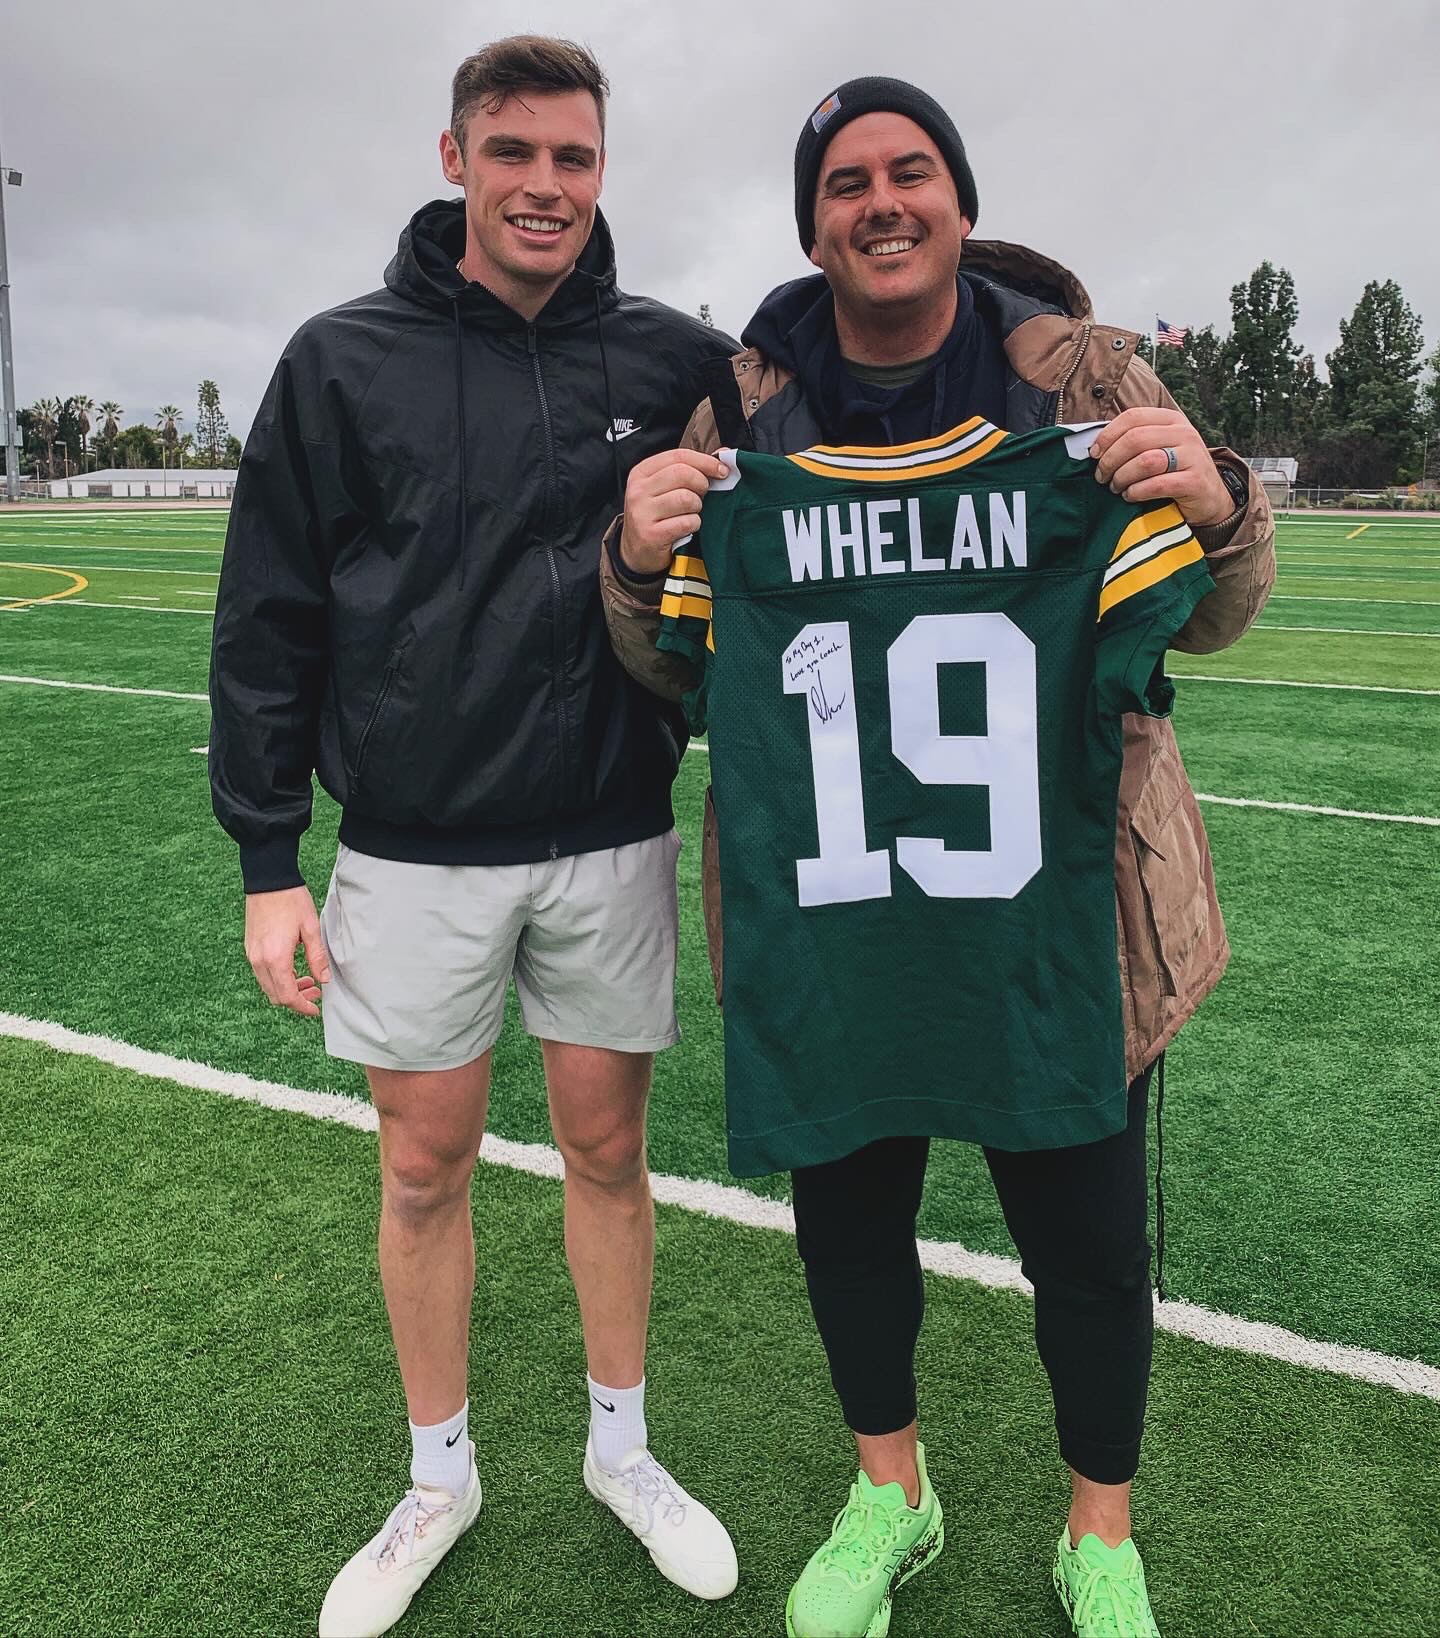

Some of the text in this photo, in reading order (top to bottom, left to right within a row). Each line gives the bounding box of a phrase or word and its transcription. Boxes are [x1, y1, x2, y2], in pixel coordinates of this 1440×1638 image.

[613, 418, 634, 432] NIKE
[782, 490, 1027, 582] WHELAN
[782, 612, 1043, 907] 19
